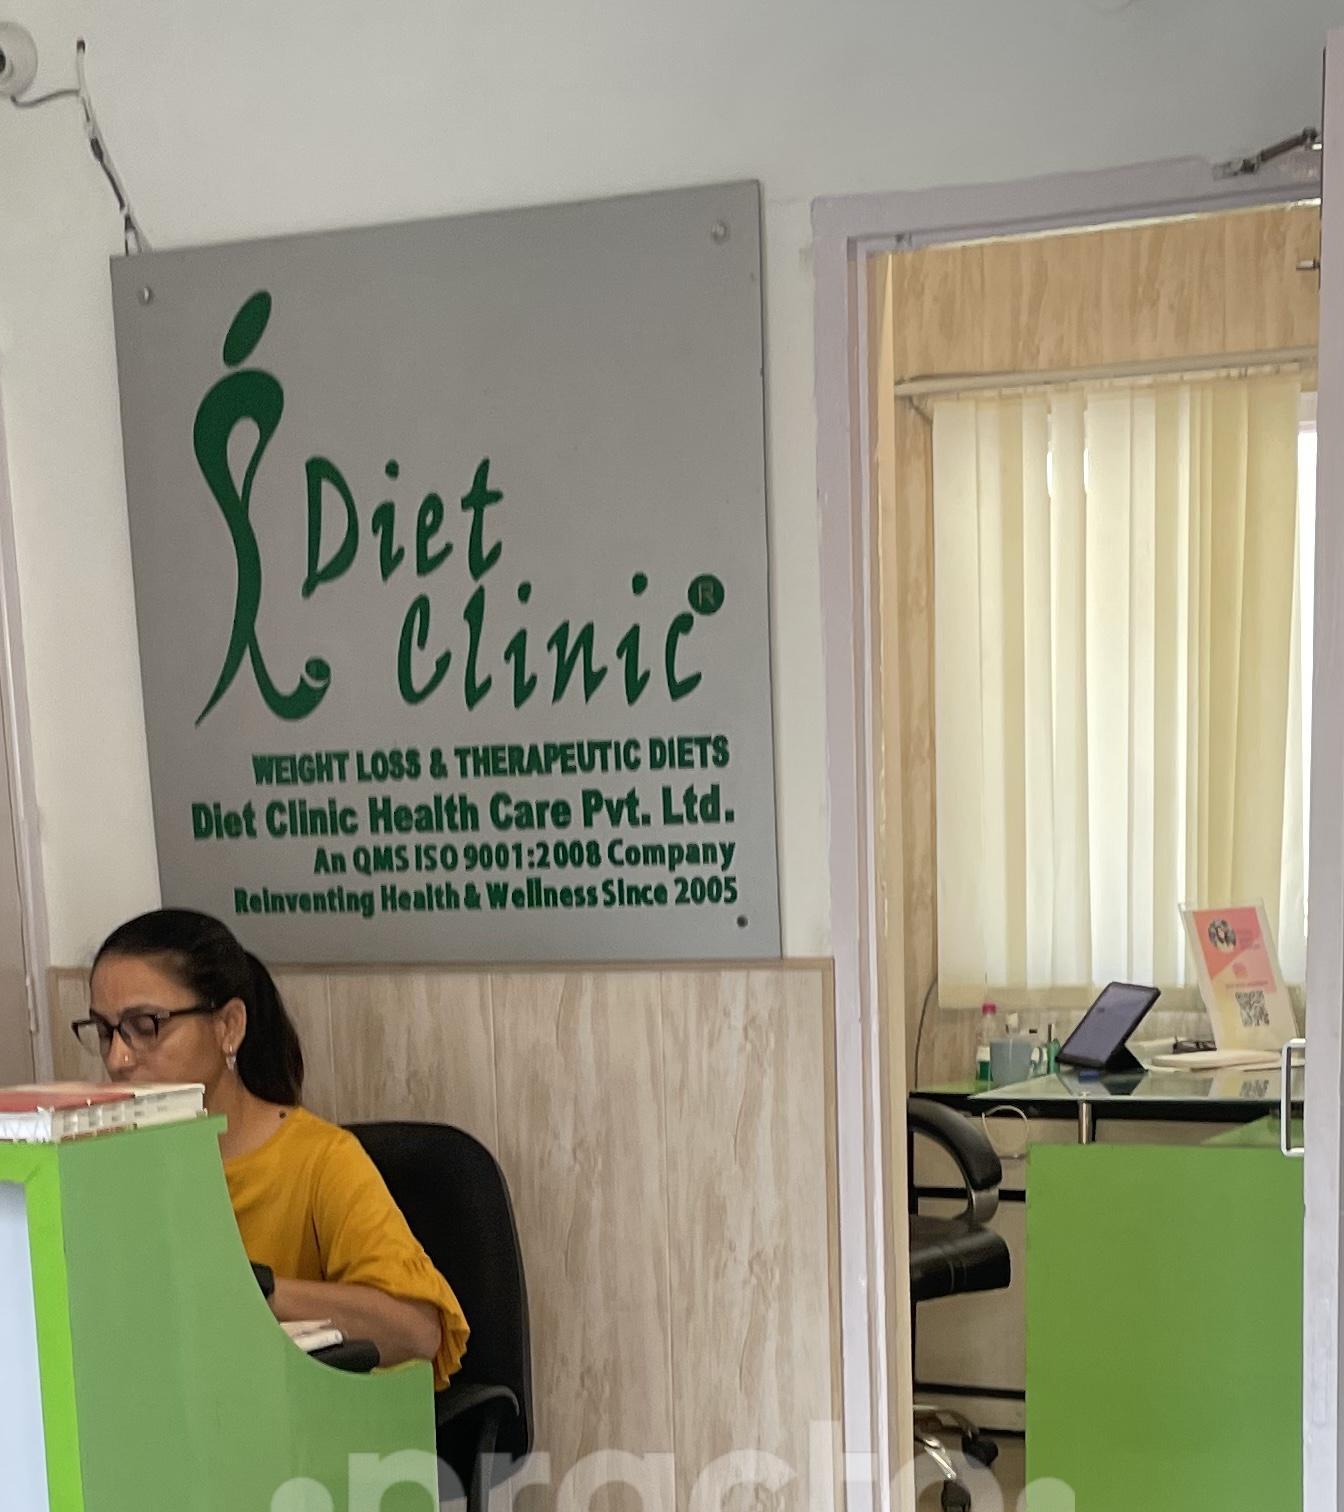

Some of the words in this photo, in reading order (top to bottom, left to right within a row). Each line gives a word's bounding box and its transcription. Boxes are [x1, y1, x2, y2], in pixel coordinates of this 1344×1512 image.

[301, 455, 504, 599] Diet
[251, 751, 350, 786] WEIGHT
[356, 746, 422, 783] LOSS
[429, 746, 449, 780] &
[453, 737, 641, 779] THERAPEUTIC
[648, 733, 731, 770] DIETS
[191, 799, 258, 842] Diet
[264, 796, 359, 839] Clinic
[367, 792, 480, 836] Health
[488, 790, 573, 832] Care
[580, 785, 652, 829] Pvt.
[661, 782, 736, 827] Ltd.
[313, 845, 348, 875] An
[352, 845, 410, 877] QMS
[414, 842, 459, 872] ISO
[462, 839, 603, 871] 9001:2008
[606, 837, 737, 873] Company
[233, 884, 375, 920] Reinventing
[380, 880, 461, 913] Health
[463, 880, 483, 910] &
[485, 875, 600, 910] Wellness
[601, 876, 669, 908] Since
[673, 874, 739, 905] 2005
